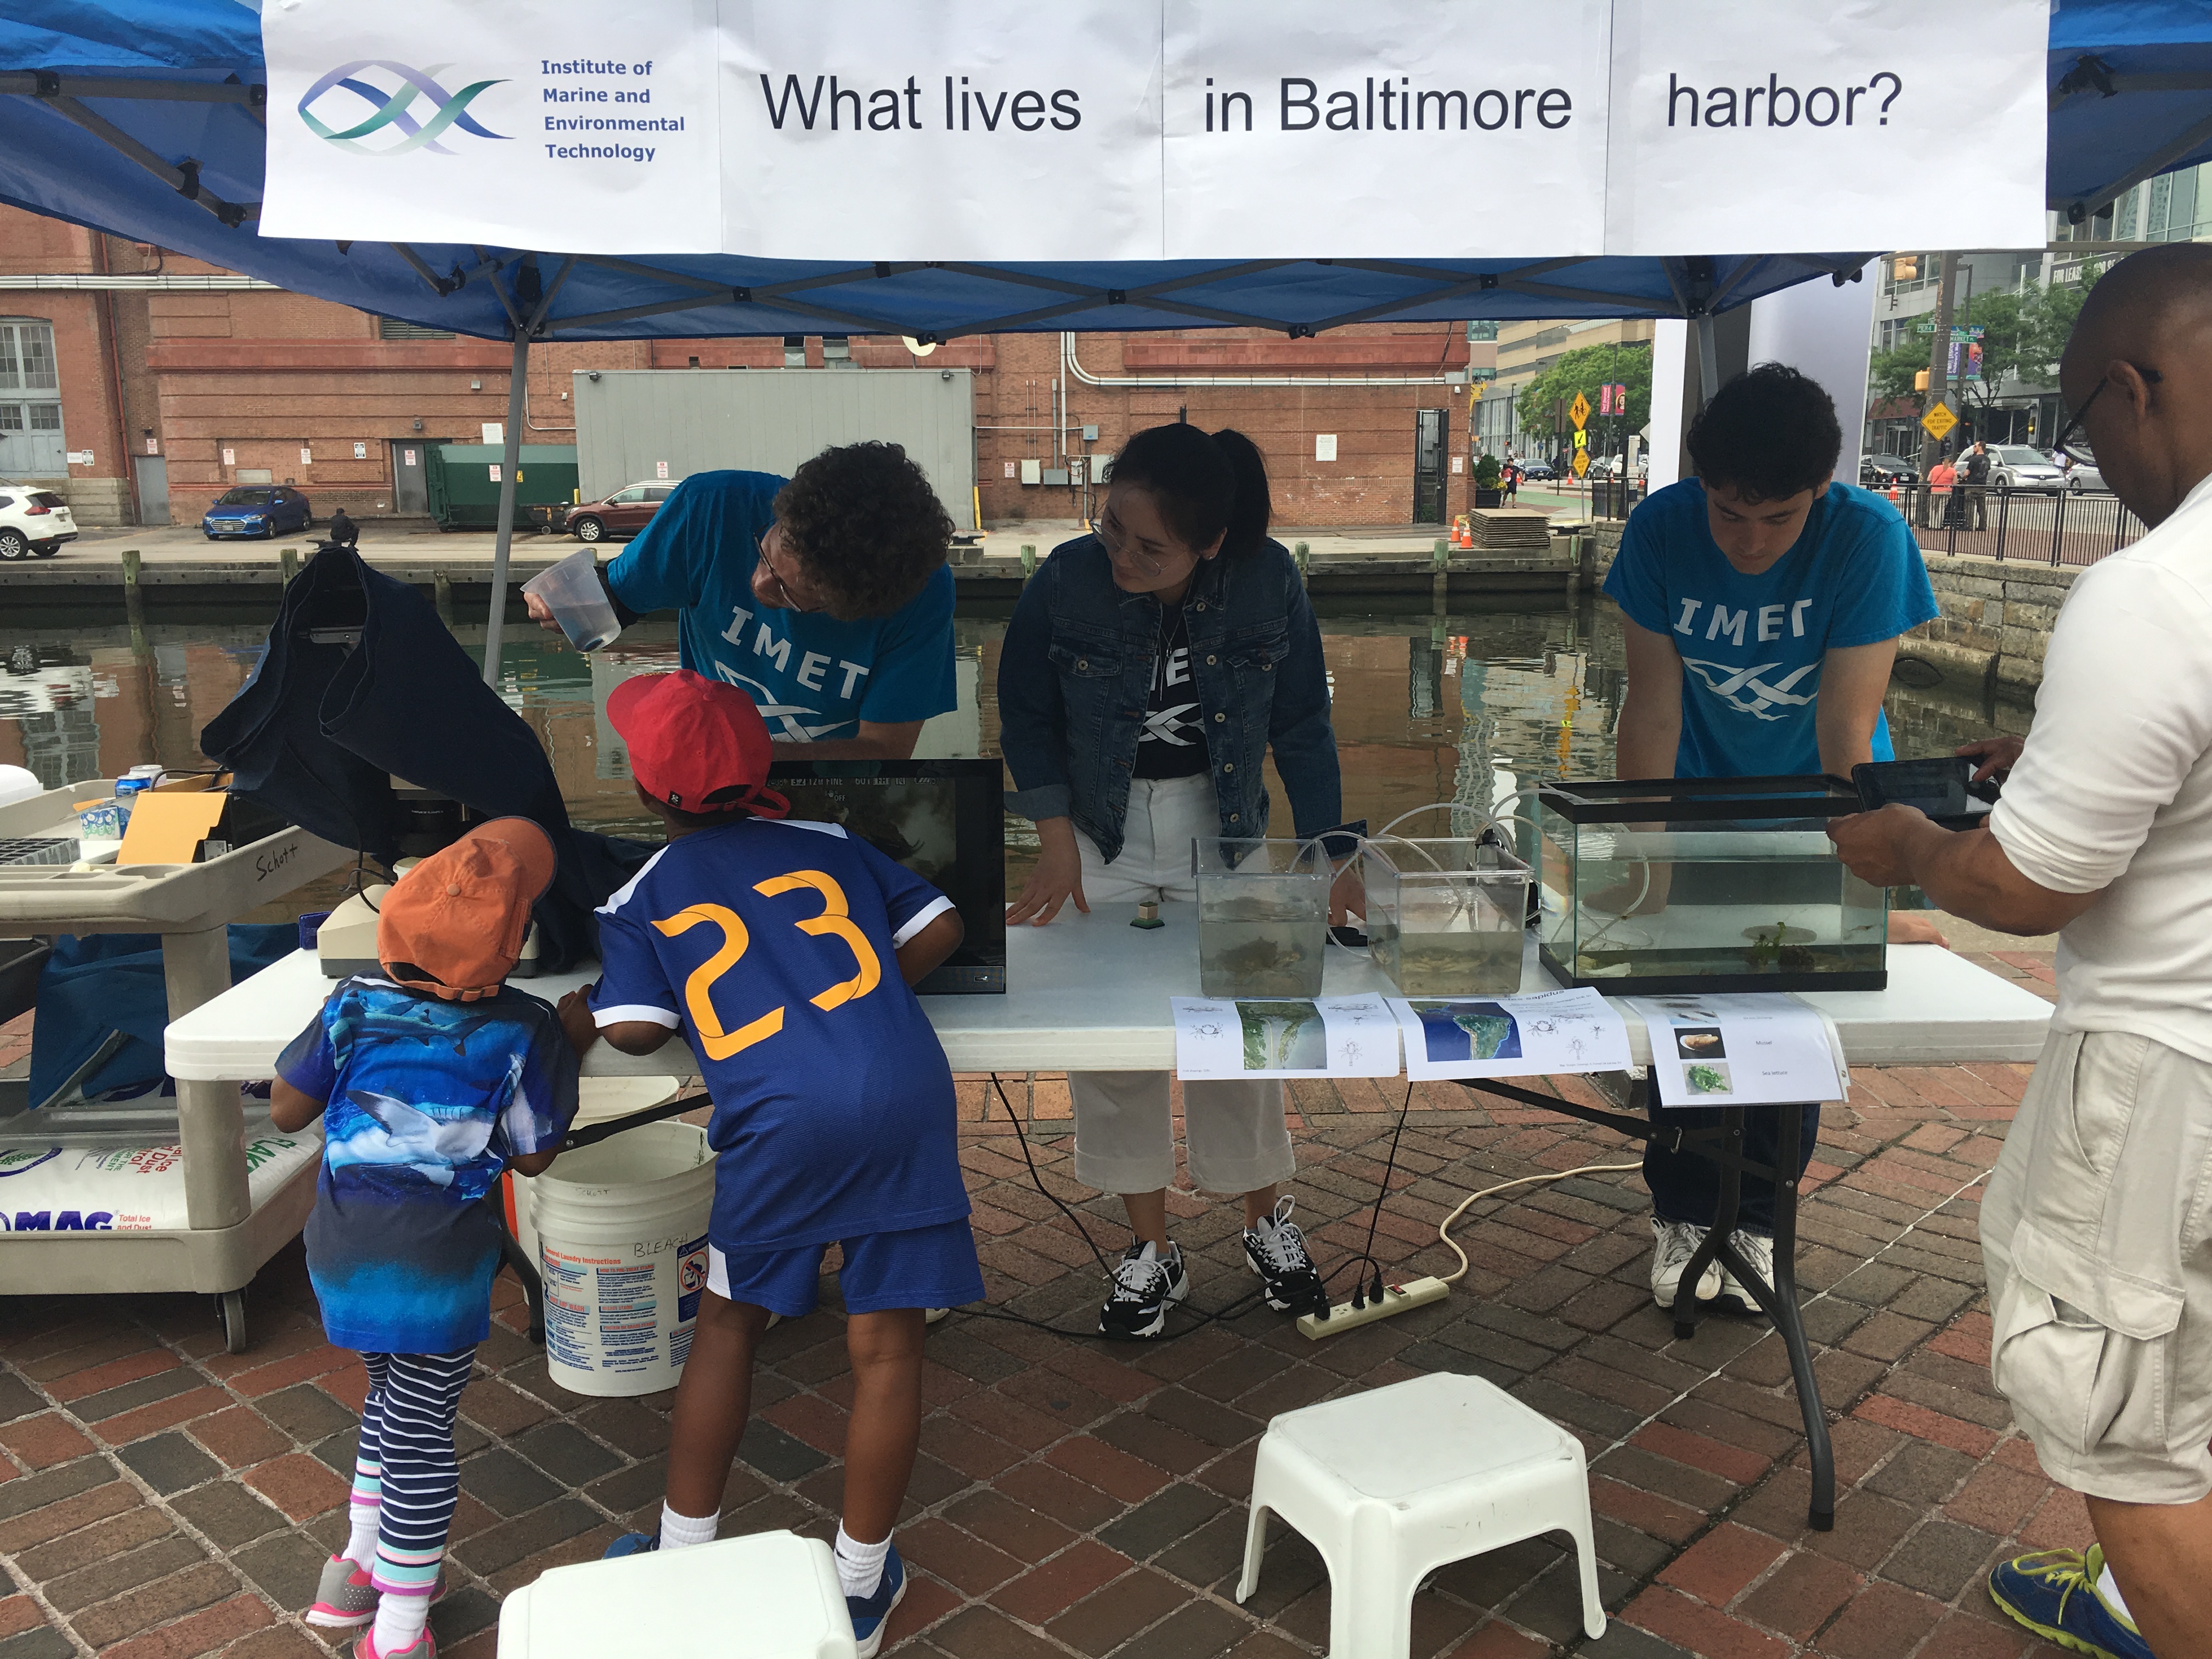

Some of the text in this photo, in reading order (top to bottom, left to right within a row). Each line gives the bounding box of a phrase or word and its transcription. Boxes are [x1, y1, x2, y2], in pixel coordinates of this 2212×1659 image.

[541, 59, 653, 76] Institute of
[543, 87, 650, 104] Marine and
[759, 72, 1903, 132] What lives in Baltimore harbor?
[544, 116, 685, 132] Environmental
[545, 144, 656, 162] Technology
[2053, 269, 2065, 284] FOR
[720, 605, 870, 700] IMET
[826, 777, 843, 785] FINE
[256, 843, 298, 882] Schott
[650, 869, 882, 1062] 23
[136, 1152, 168, 1173] Dust
[155, 1159, 179, 1172] Ice
[119, 1214, 138, 1222] Total
[634, 1233, 689, 1258] BLEACH
[545, 1245, 622, 1265] General Laundry Instructions
[569, 1303, 585, 1312] WASH
